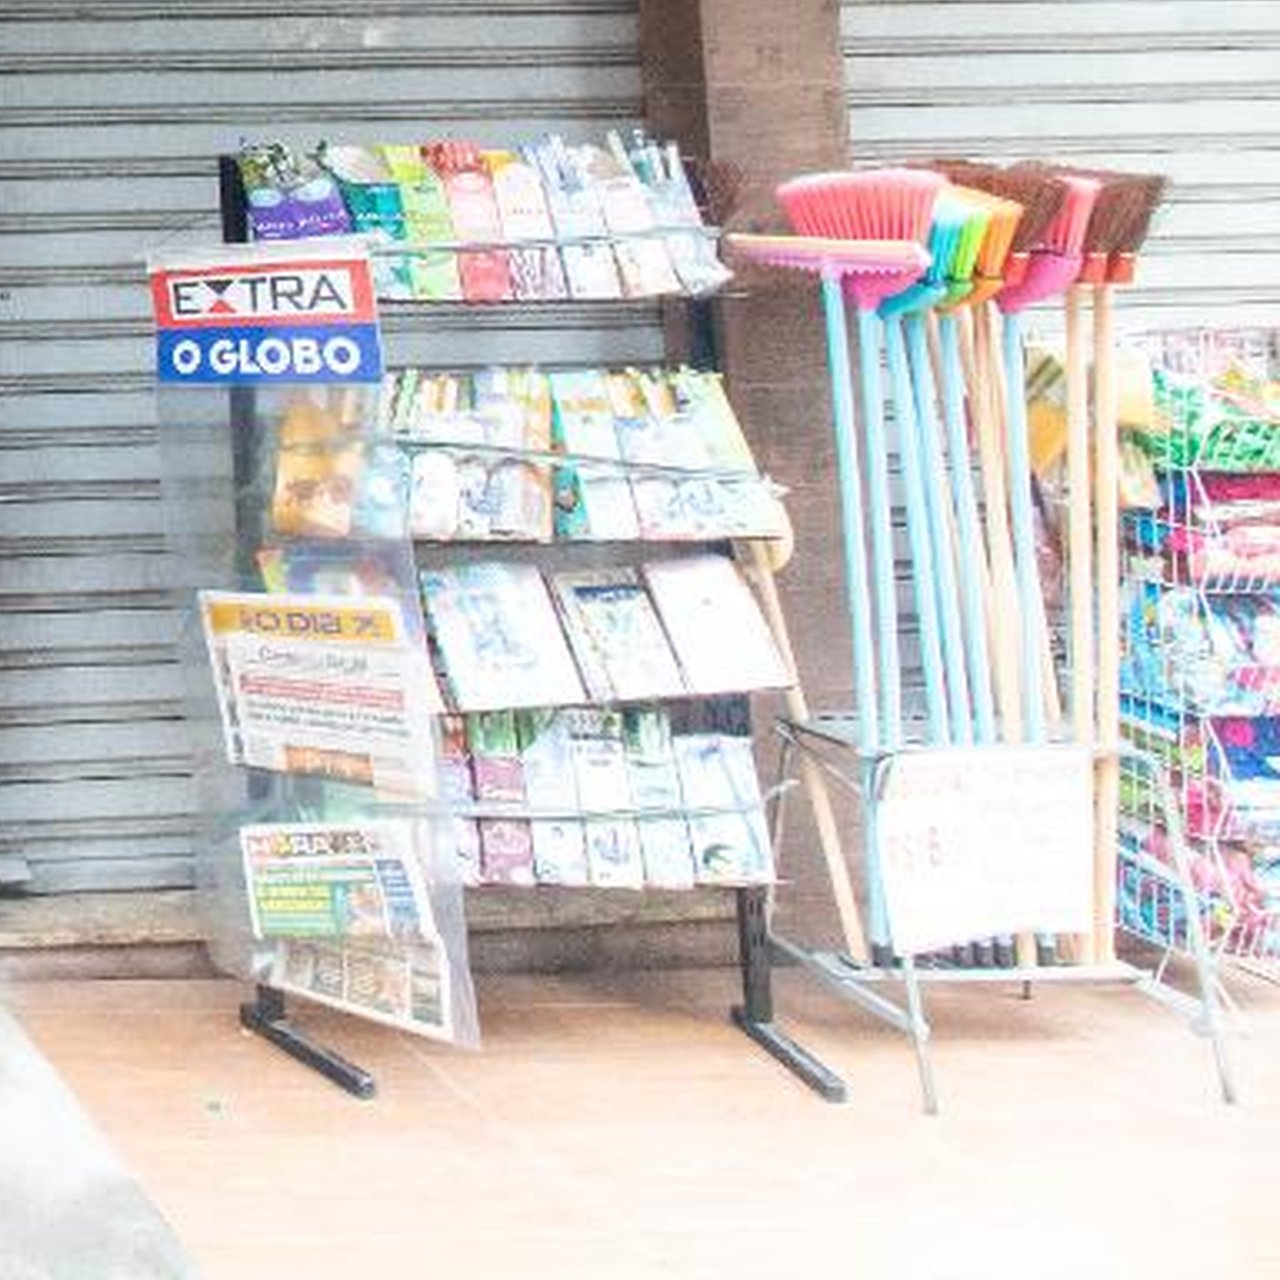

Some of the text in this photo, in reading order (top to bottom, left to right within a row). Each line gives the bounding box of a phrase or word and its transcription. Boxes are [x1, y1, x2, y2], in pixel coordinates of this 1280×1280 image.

[172, 273, 347, 315] EXTRA
[172, 335, 361, 375] O GLOBO
